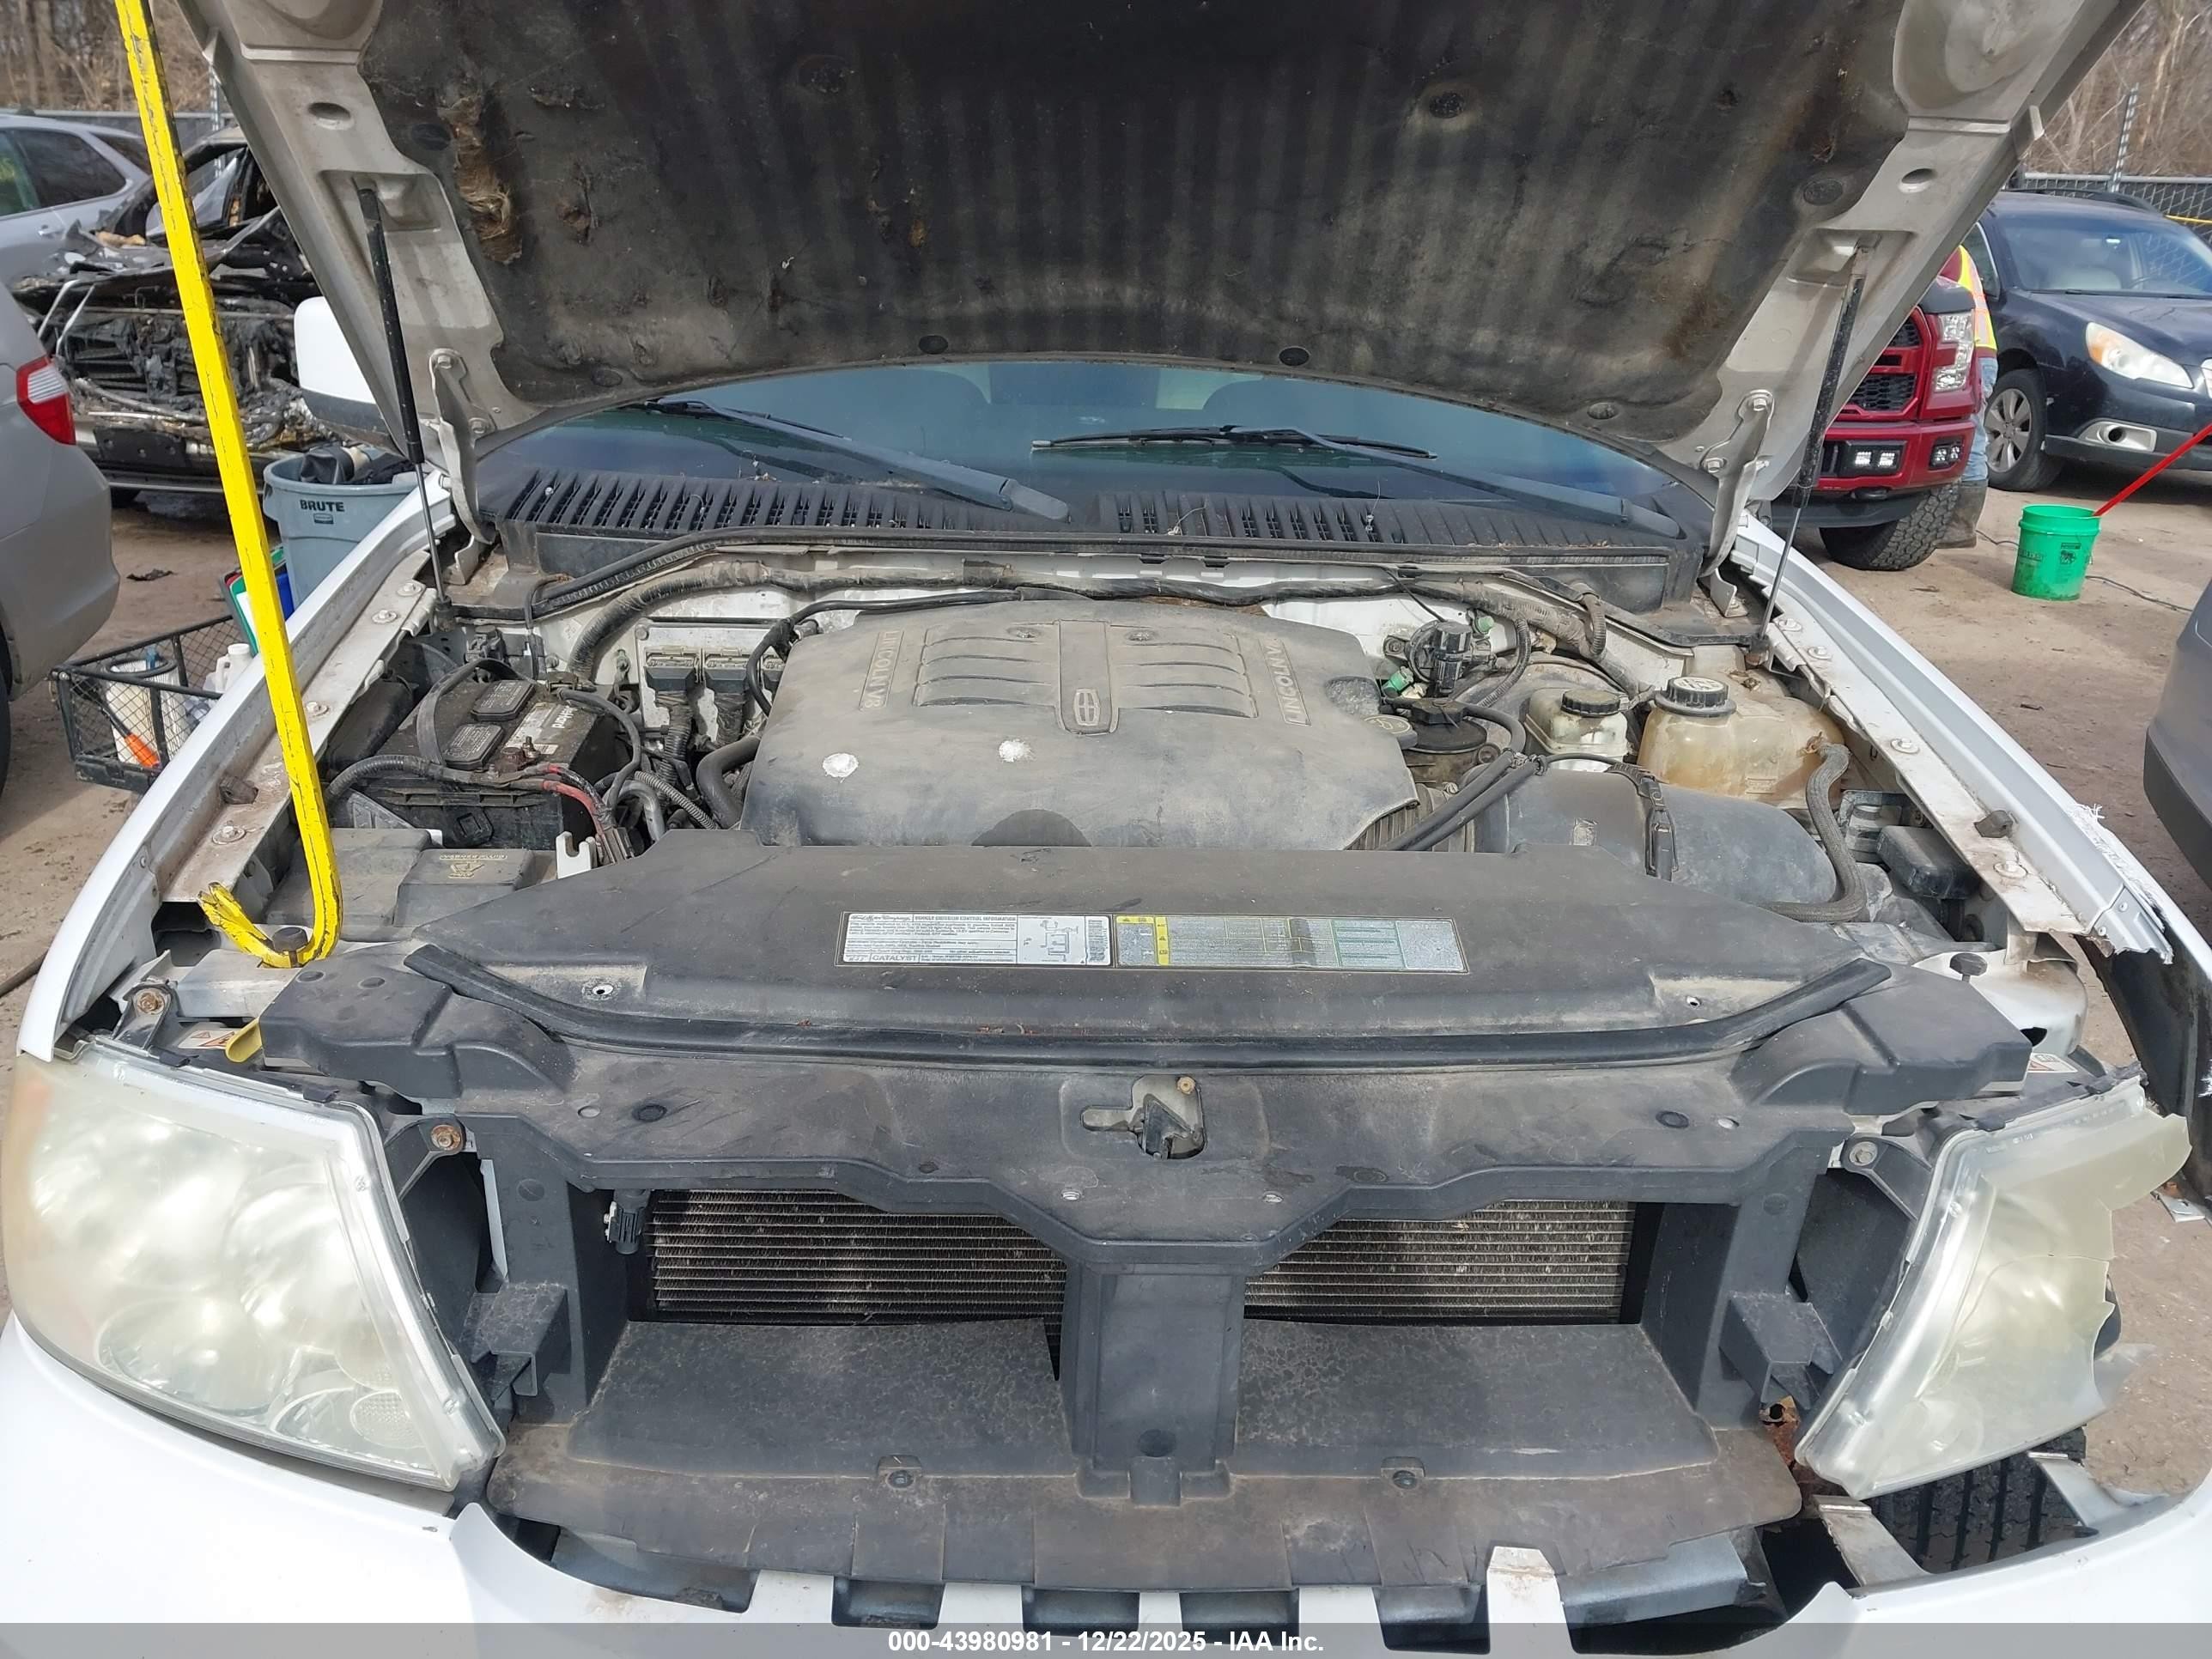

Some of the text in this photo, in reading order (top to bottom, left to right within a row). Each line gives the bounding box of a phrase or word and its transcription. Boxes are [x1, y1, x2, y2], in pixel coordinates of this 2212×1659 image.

[300, 499, 345, 513] BRUTE
[864, 629, 901, 708] LINCOLN V8
[1268, 657, 1308, 725] LINCOLN
